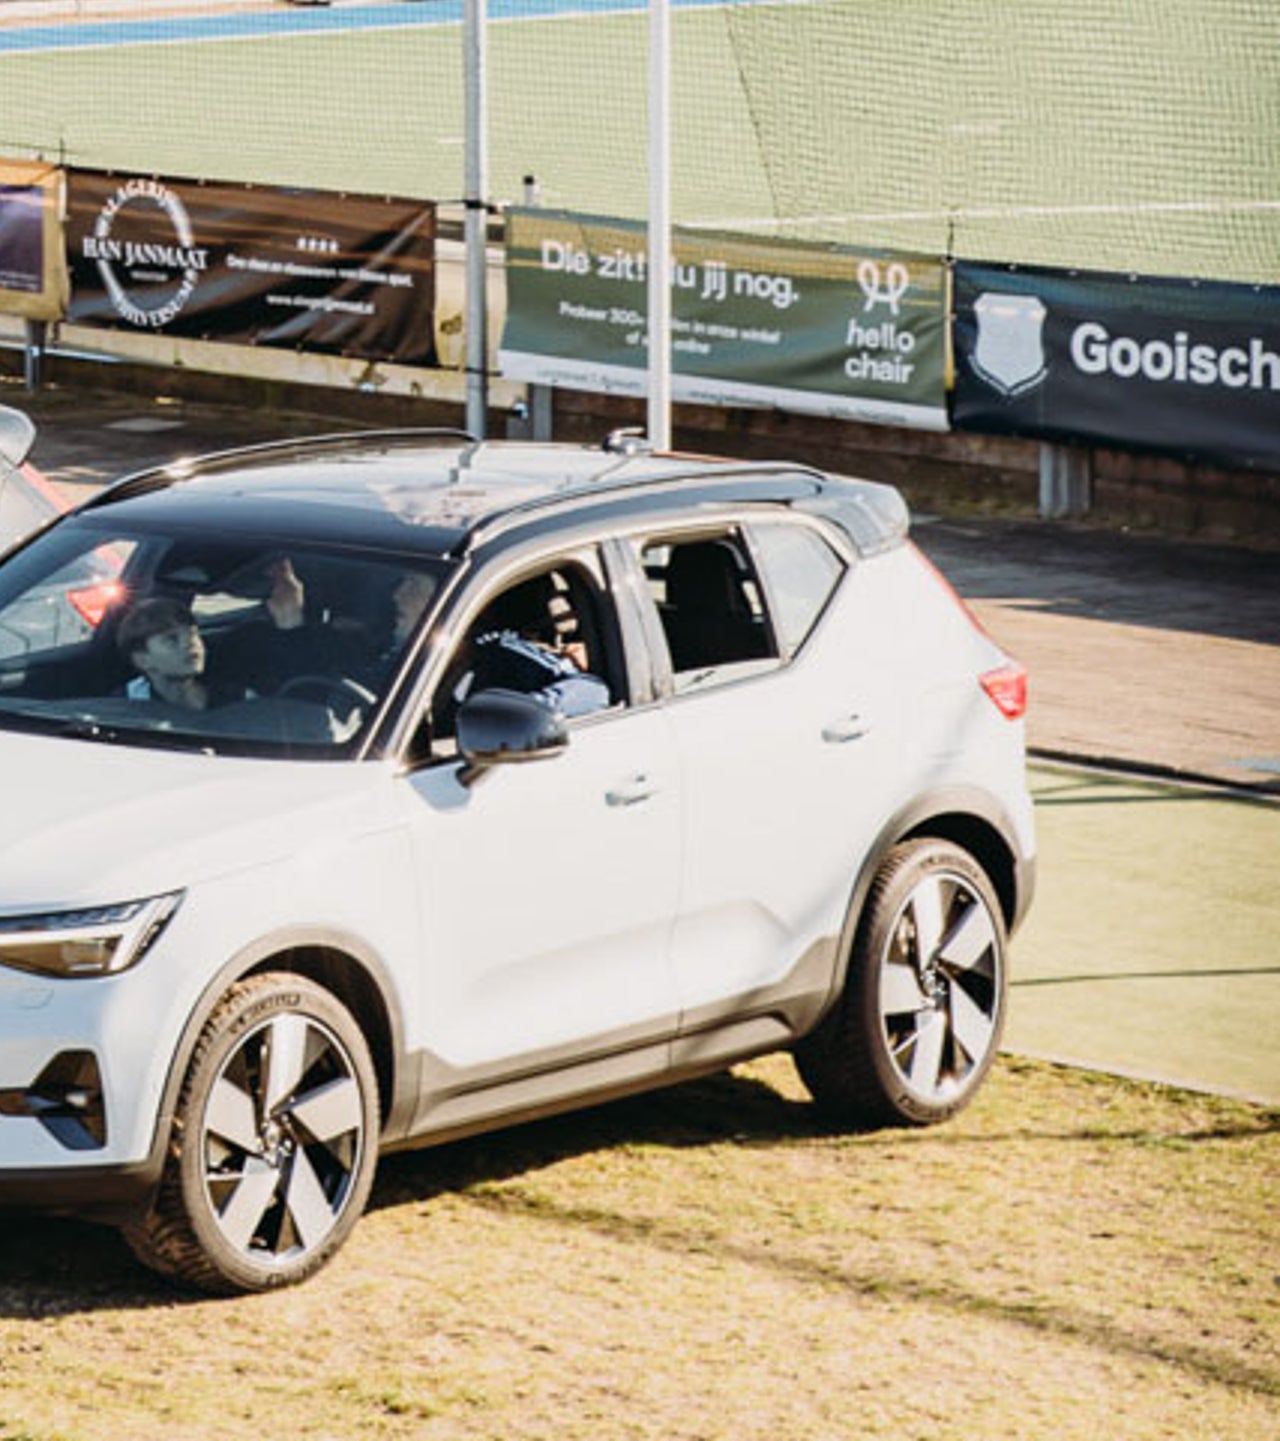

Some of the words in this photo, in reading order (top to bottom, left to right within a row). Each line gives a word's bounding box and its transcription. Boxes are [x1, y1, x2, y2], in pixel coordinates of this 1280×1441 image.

[82, 235, 122, 260] HAN
[124, 241, 208, 271] JANMAAT
[540, 240, 590, 275] Die
[597, 248, 645, 282] zit!
[701, 260, 727, 301] jij
[733, 271, 801, 309] nog.
[844, 318, 917, 353] hello
[843, 351, 916, 385] chair
[1069, 320, 1280, 390] Gooisch
